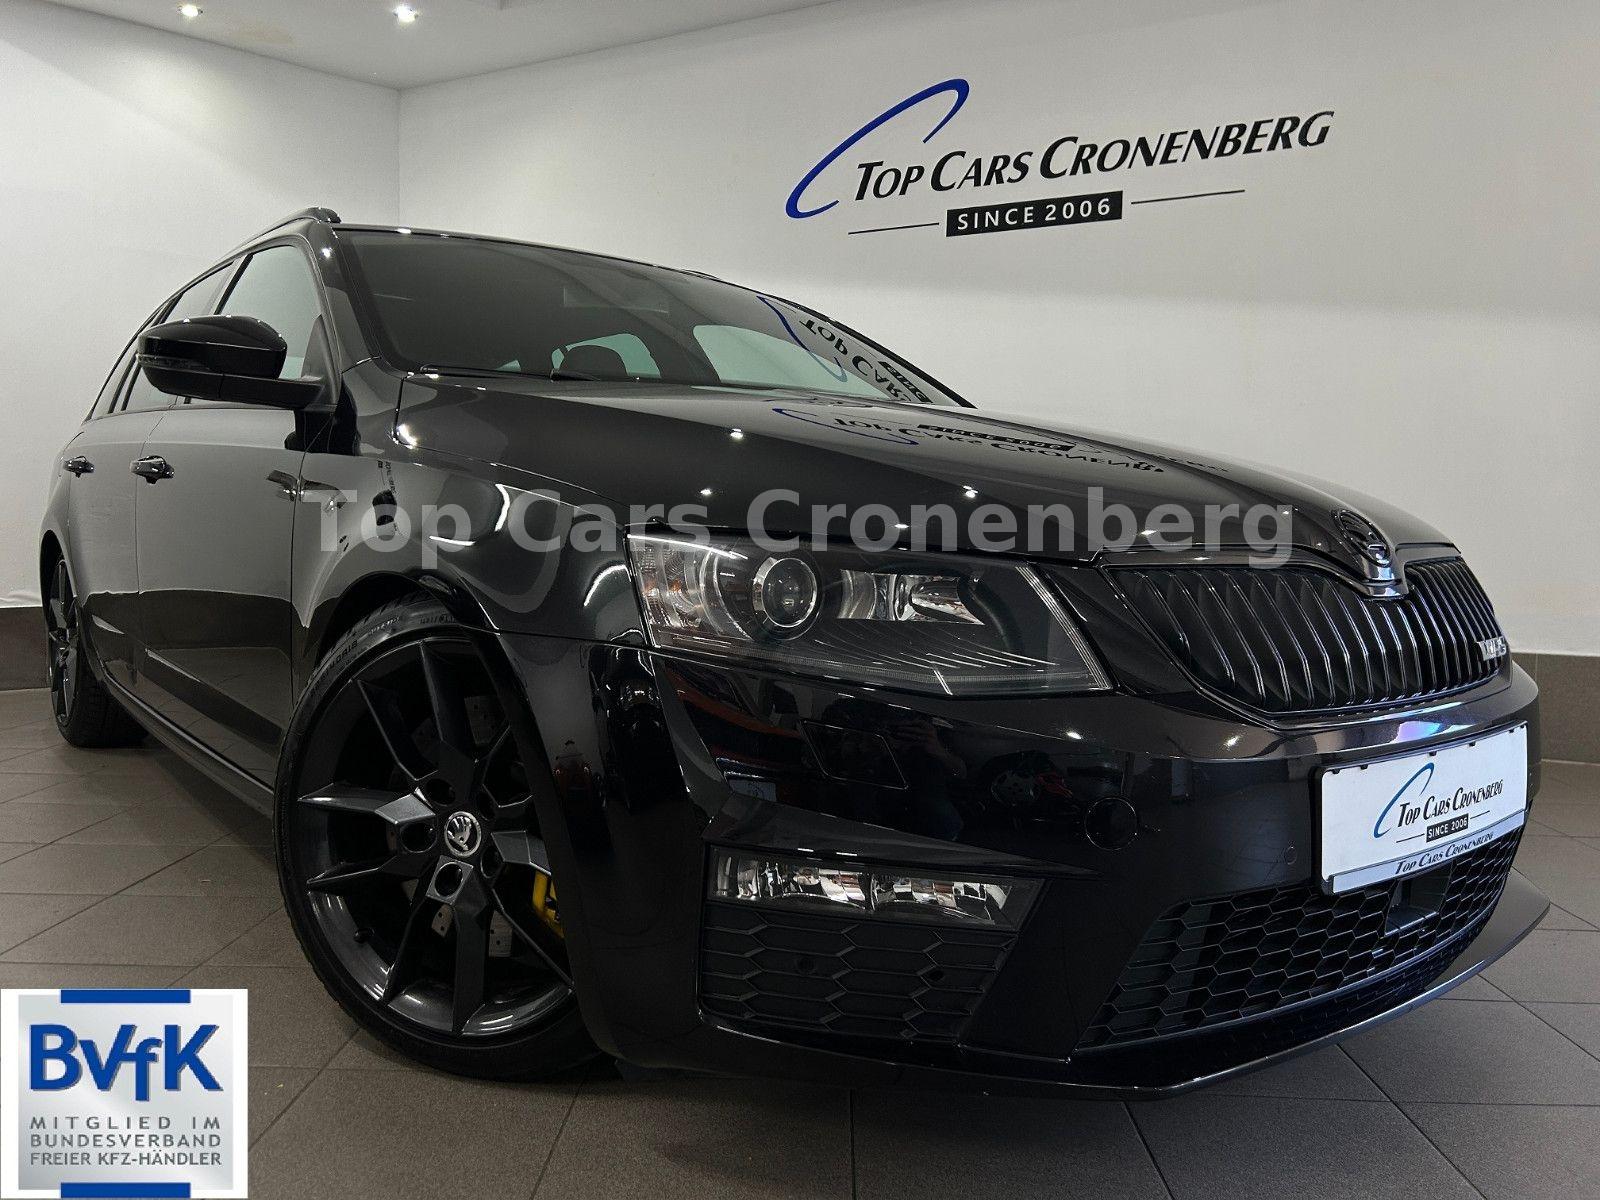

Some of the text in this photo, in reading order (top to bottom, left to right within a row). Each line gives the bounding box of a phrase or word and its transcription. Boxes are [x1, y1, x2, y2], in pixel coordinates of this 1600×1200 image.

[855, 110, 1335, 201] TOP CARS CRONENBERG
[957, 197, 1112, 230] SINCE 2006
[1423, 795, 1451, 820] CARS
[1428, 816, 1468, 838] SINCE 2006
